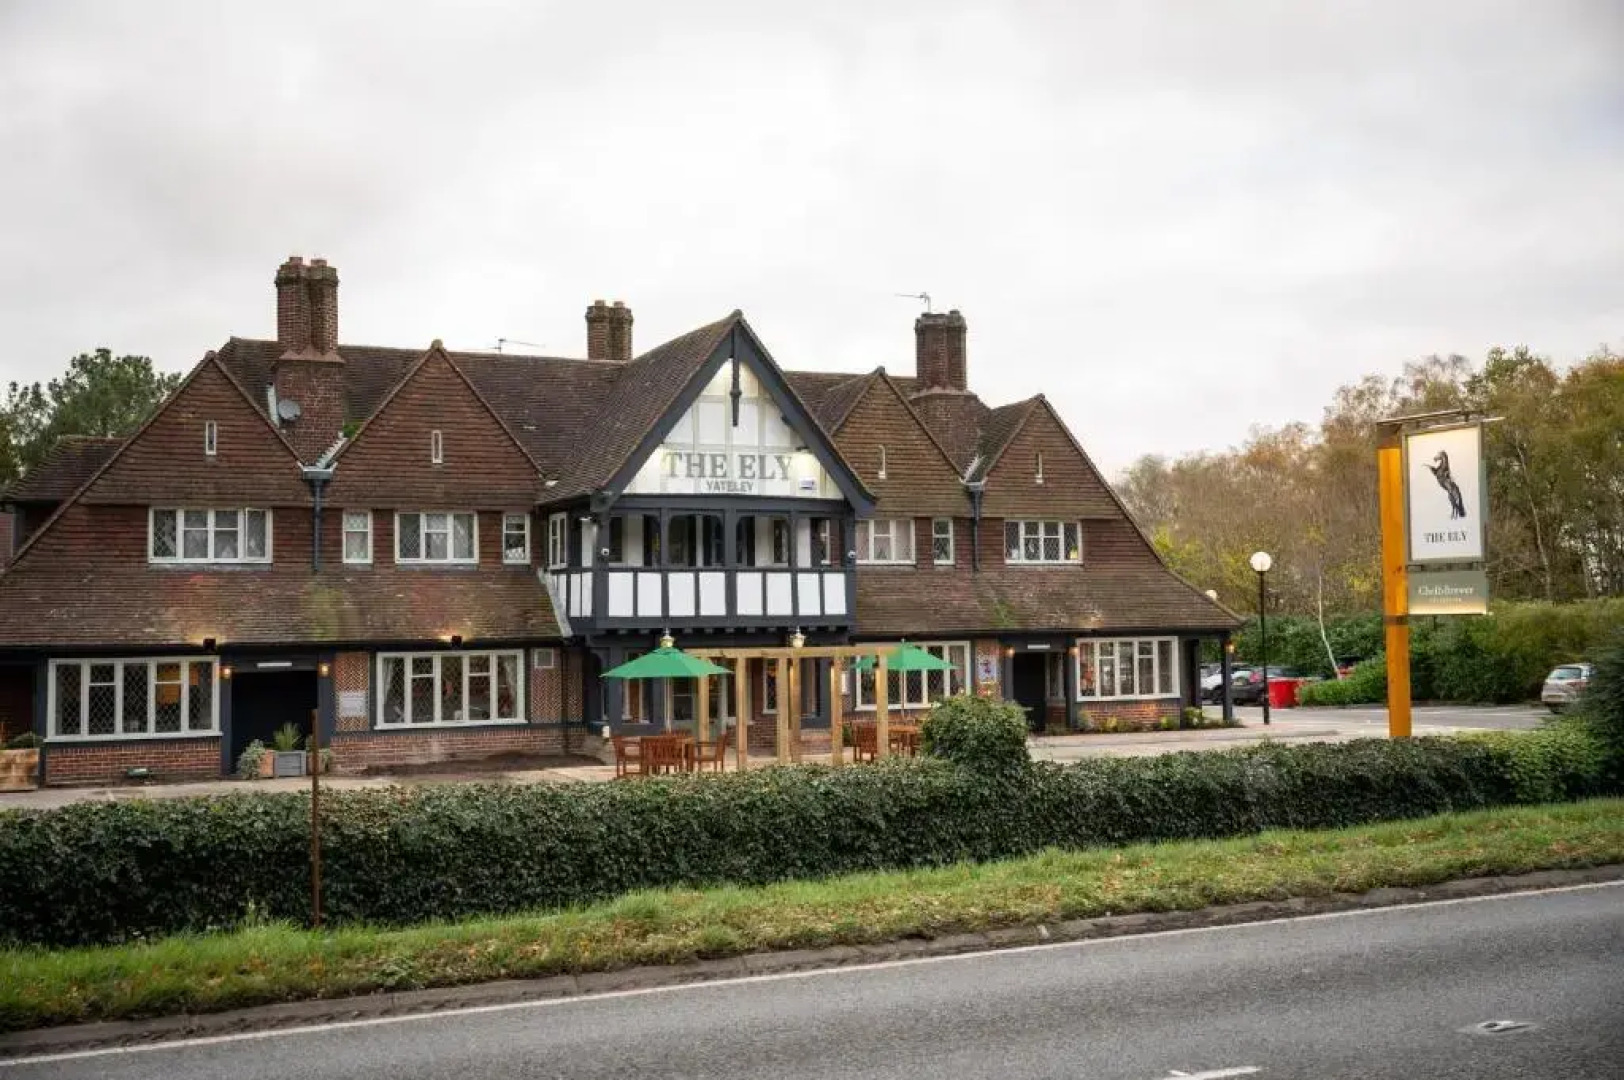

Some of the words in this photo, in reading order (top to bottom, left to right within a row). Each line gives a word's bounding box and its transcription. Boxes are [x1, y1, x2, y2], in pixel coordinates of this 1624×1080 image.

[665, 452, 727, 478] THE
[738, 454, 792, 480] ELY
[706, 481, 754, 492] YATELEY
[1423, 532, 1446, 544] THE
[1447, 531, 1467, 542] ELY
